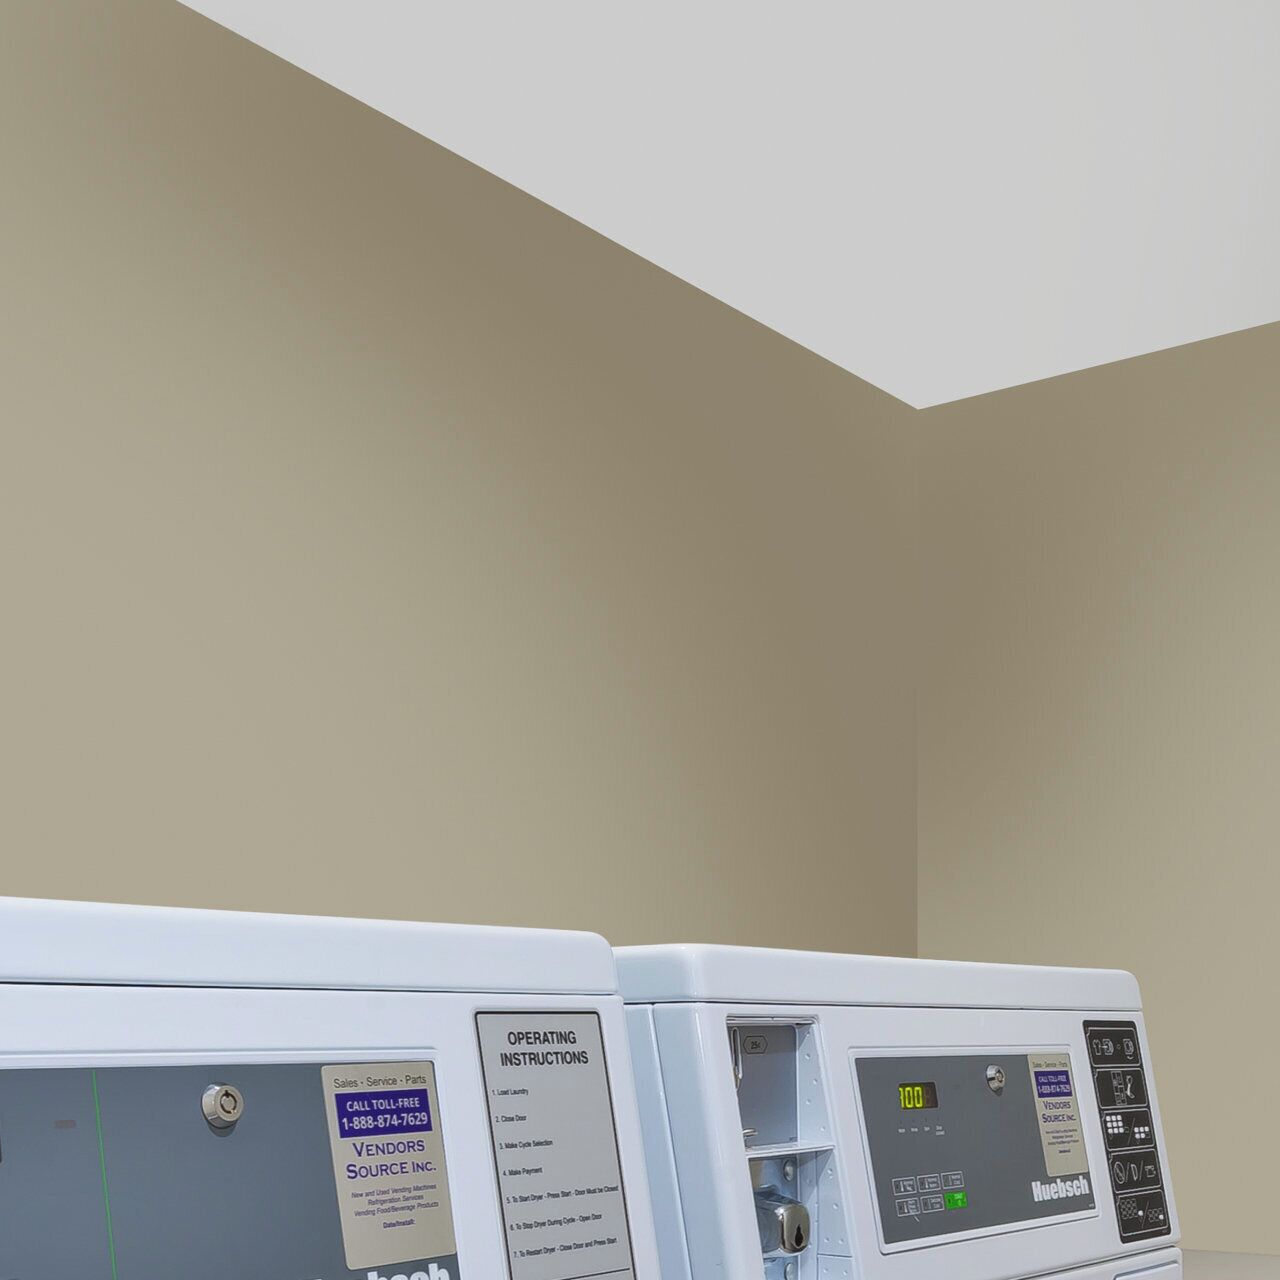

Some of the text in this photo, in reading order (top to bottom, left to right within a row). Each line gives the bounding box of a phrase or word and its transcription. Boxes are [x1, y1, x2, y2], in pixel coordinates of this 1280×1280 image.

[507, 1030, 577, 1045] OPERATING
[500, 1050, 589, 1067] INSTRUCTIONS
[333, 1074, 427, 1089] Sales Service Parts
[510, 1088, 529, 1096] Laundry
[346, 1097, 420, 1112] CALL TOLL-FREE
[1042, 1100, 1071, 1110] VENDORS
[342, 1112, 428, 1131] 1-888-874-7629
[352, 1140, 425, 1157] VENDORS
[518, 1141, 532, 1149] Cycle
[346, 1161, 437, 1179] SOURCE INC.
[522, 1167, 543, 1176] Payment
[1031, 1175, 1090, 1202] Huebsch
[354, 1209, 376, 1217] Vending
